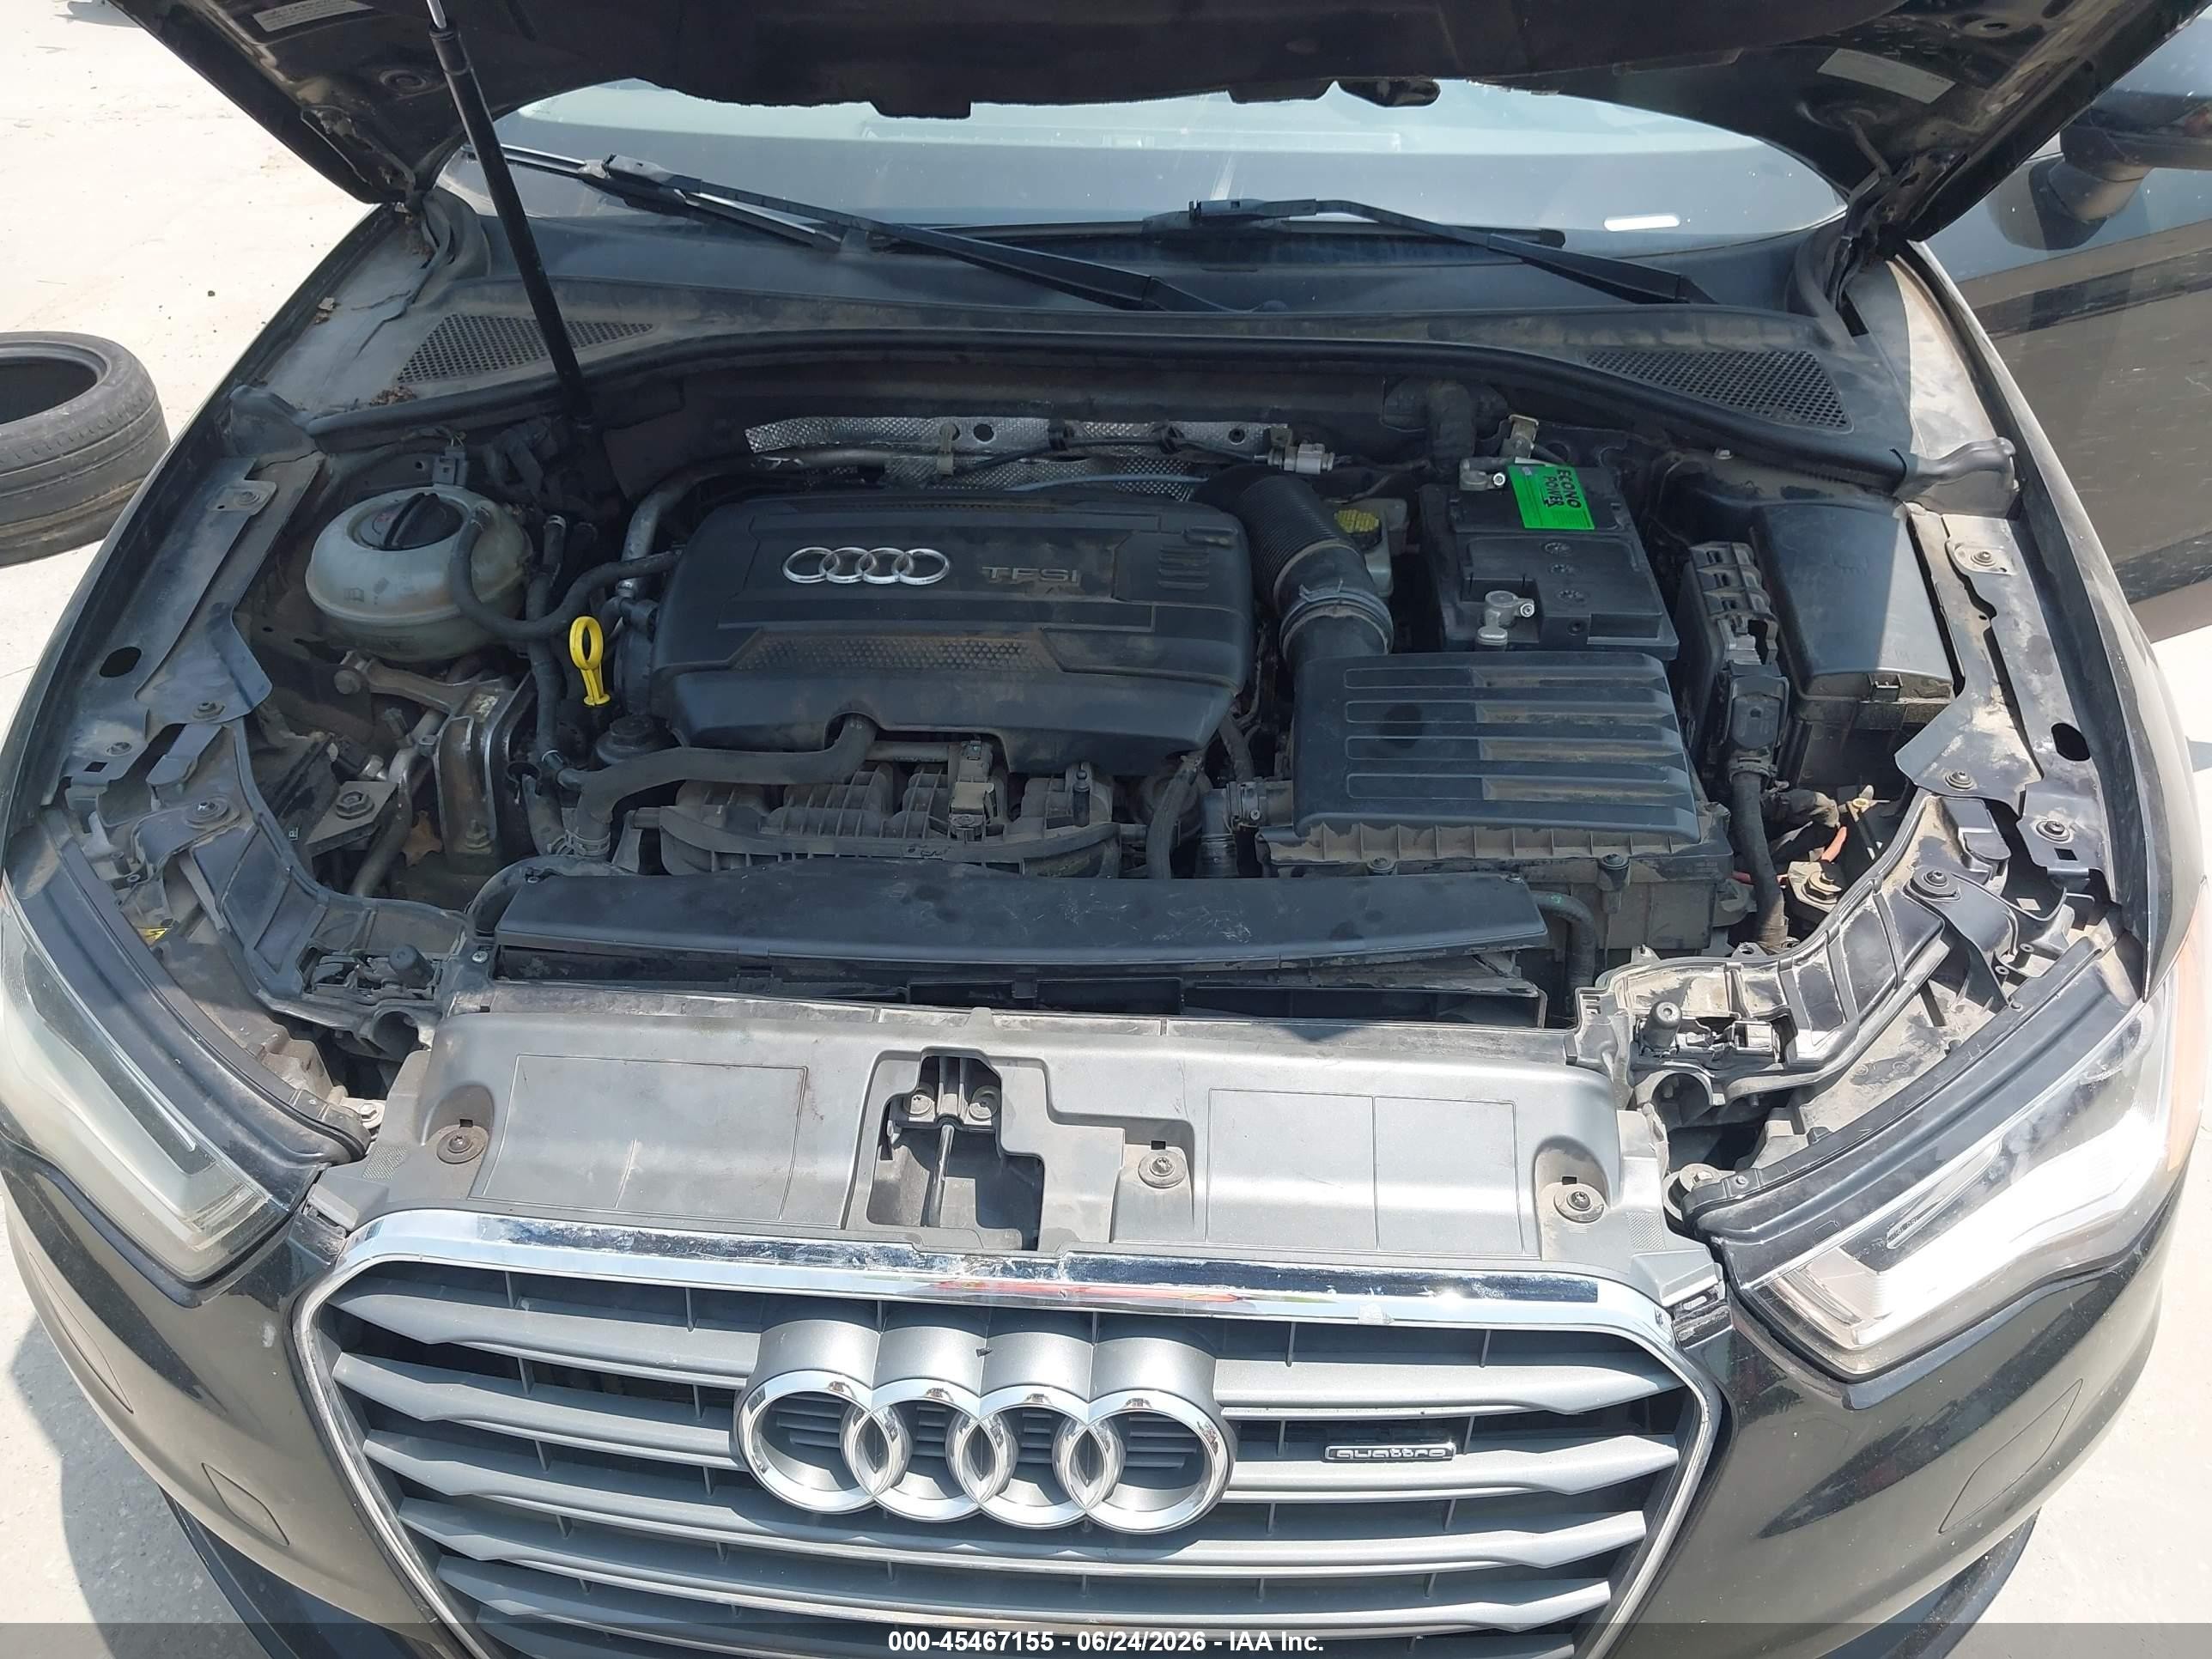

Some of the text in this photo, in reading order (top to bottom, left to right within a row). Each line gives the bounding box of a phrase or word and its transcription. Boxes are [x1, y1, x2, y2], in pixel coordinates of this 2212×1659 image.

[1544, 476, 1565, 508] POWER
[1557, 469, 1582, 508] ECONO
[981, 566, 1079, 583] TFSI
[1336, 1447, 1447, 1460] quattro
